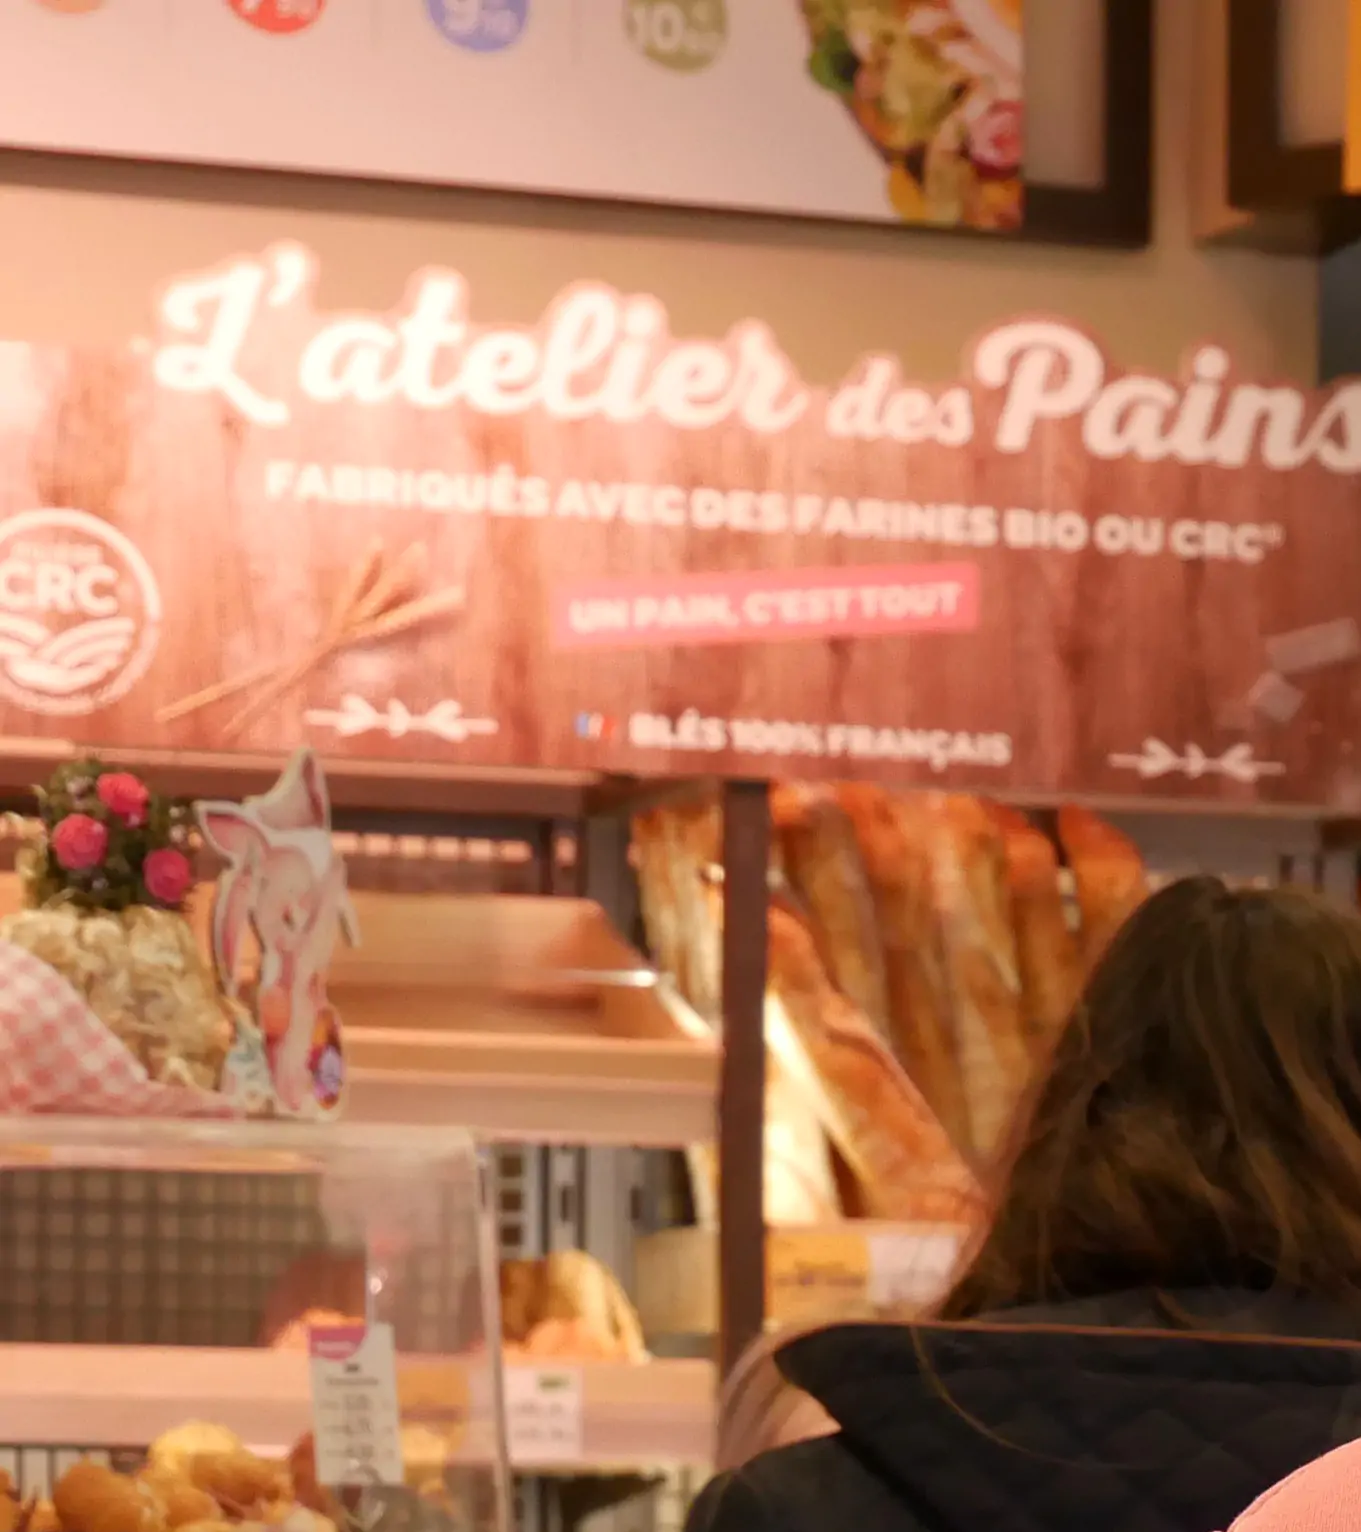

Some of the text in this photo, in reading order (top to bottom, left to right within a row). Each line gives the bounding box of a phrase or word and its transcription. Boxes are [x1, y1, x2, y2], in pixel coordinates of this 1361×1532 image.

[152, 240, 806, 432] L'atelier
[825, 352, 975, 447] des
[265, 461, 551, 516] FABRIQUÉS
[556, 478, 687, 526] AVEC
[691, 486, 790, 534] DES
[794, 493, 998, 546] FARINES
[1004, 507, 1088, 552] BIO
[1094, 513, 1163, 555] OU
[0, 559, 119, 617] CRC
[568, 598, 629, 634] UN
[858, 581, 962, 619] TOUT
[826, 724, 1012, 773] FRANÇAIS
